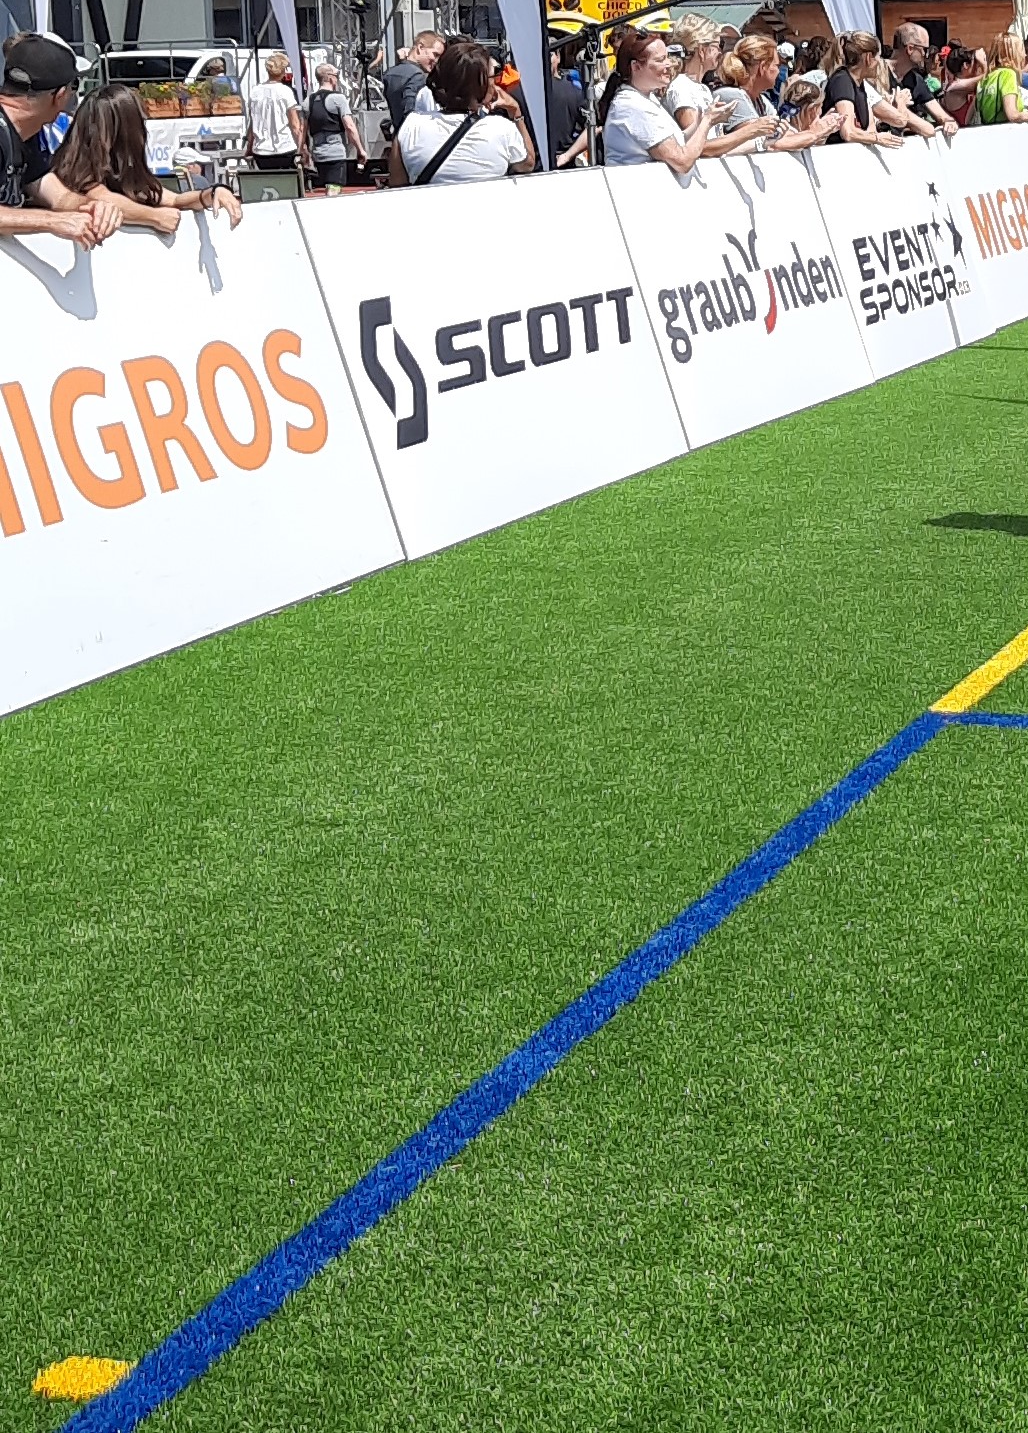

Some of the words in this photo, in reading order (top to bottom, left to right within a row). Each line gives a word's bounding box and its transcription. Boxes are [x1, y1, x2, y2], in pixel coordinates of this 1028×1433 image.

[852, 222, 934, 283] EVENT
[859, 264, 960, 326] SPONSOR
[435, 286, 635, 394] SCOTT
